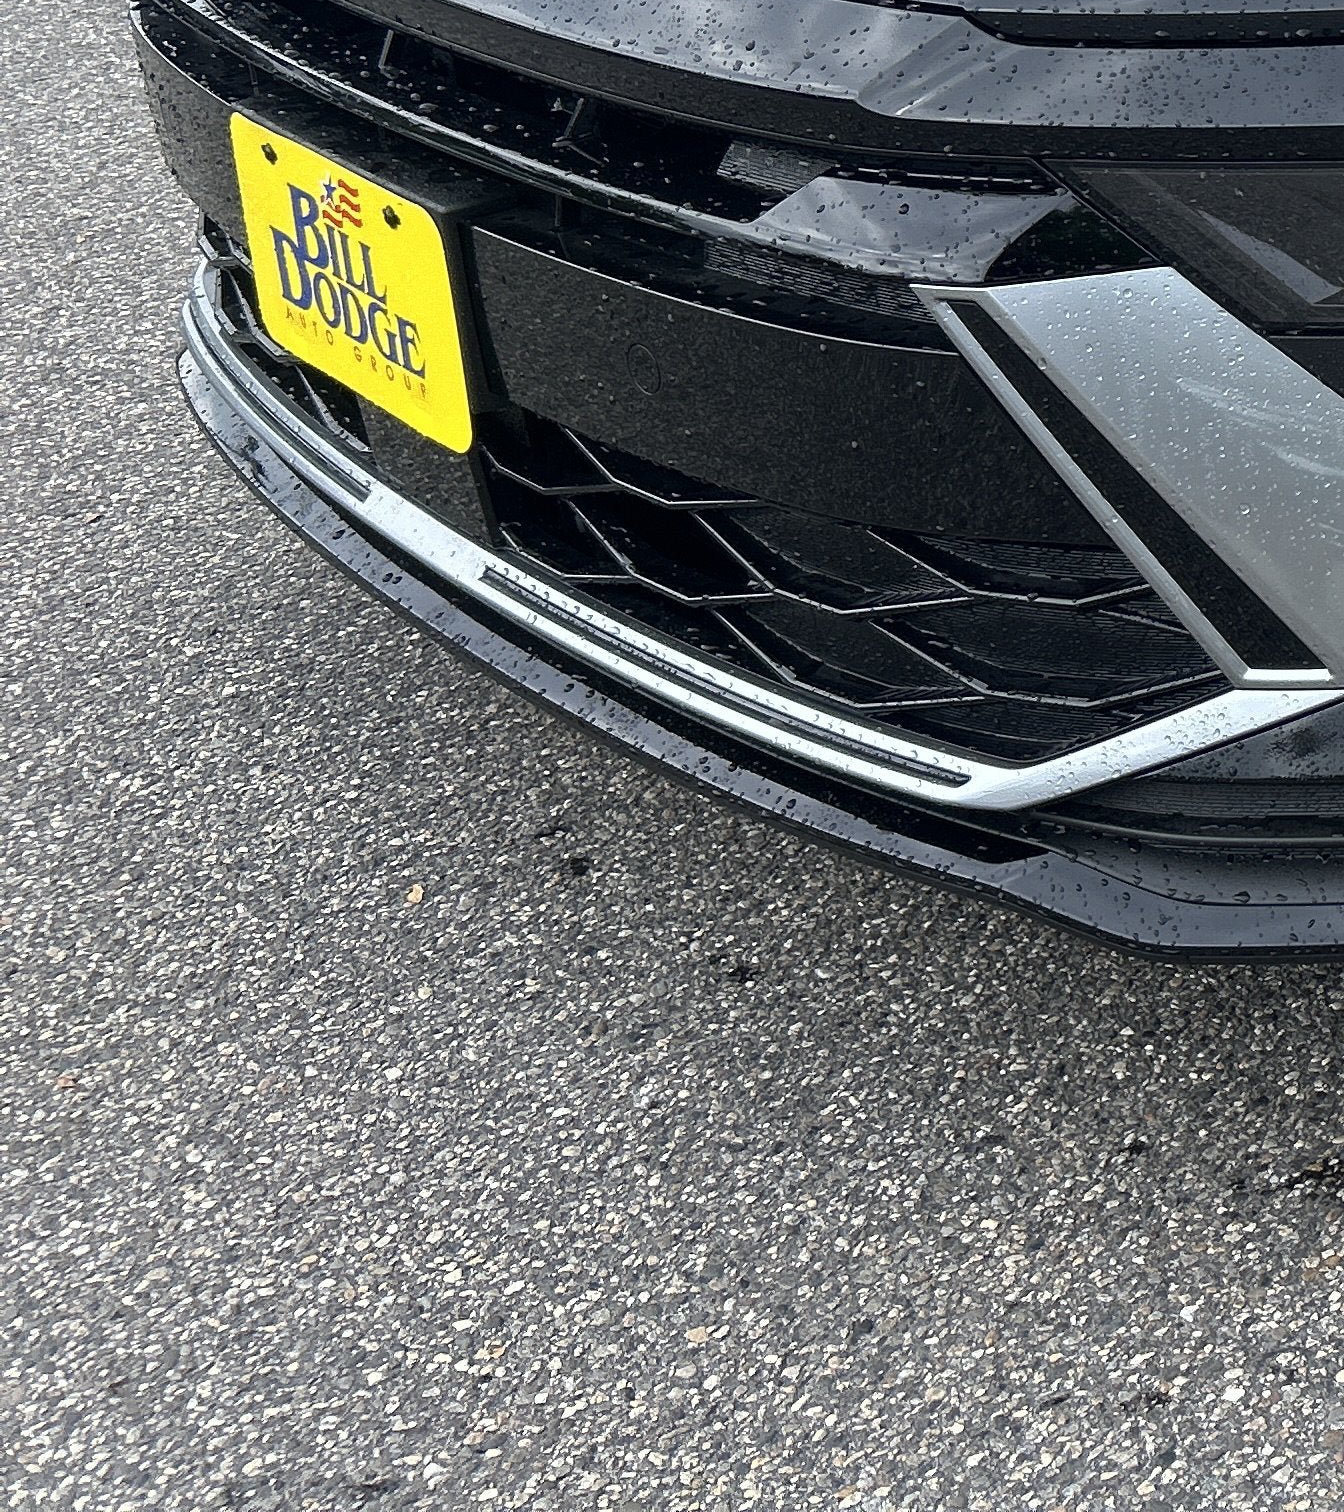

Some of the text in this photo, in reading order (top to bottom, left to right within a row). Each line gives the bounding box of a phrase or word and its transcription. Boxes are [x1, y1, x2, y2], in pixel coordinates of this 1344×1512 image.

[269, 225, 427, 379] DODGE
[286, 182, 388, 305] BILL
[285, 306, 430, 399] AUTO GROUP
